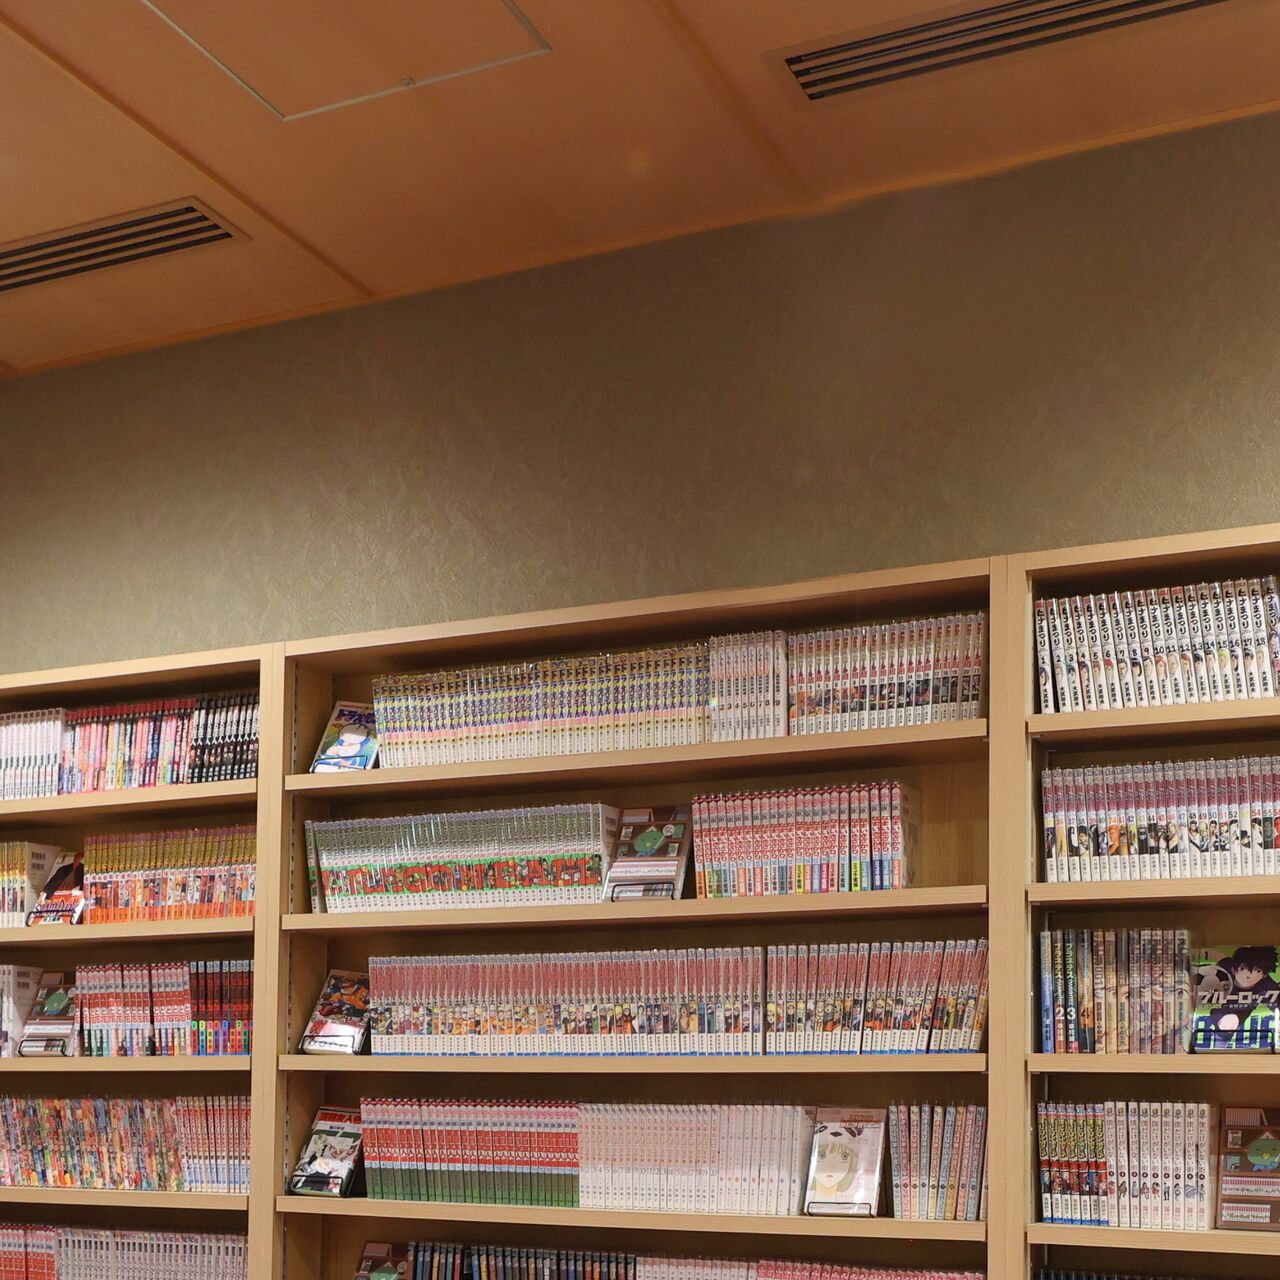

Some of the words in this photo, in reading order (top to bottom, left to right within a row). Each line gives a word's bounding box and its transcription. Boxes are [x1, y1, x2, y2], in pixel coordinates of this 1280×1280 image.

[1155, 646, 1164, 654] 10
[1197, 991, 1280, 1003] ブルーロック
